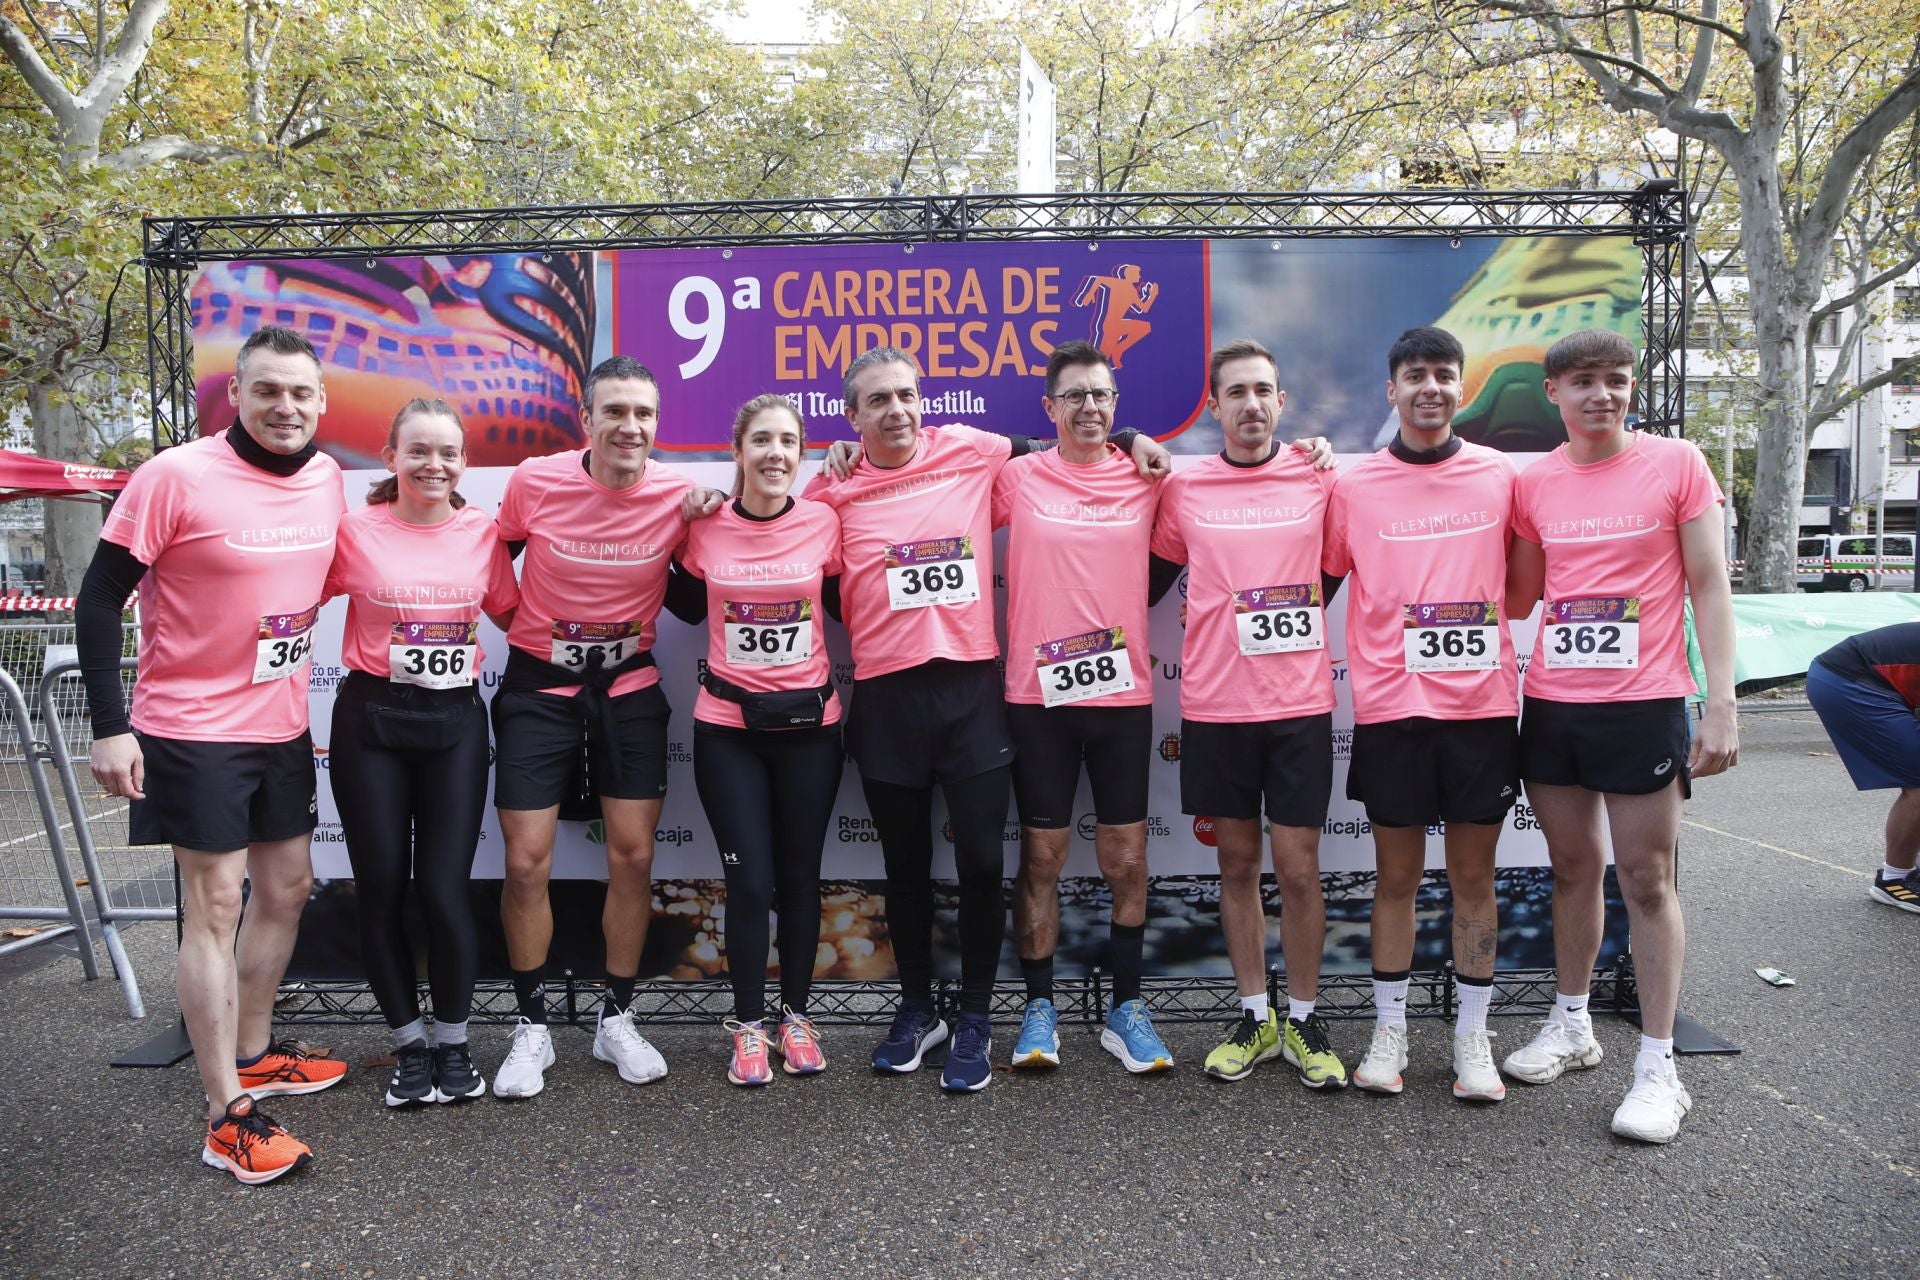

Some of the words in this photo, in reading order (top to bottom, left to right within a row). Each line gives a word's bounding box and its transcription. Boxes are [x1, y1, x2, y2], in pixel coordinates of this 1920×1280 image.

[773, 267, 988, 318] CARRERA
[1002, 267, 1061, 314] DE
[775, 319, 1062, 380] EMPRESAS
[914, 546, 948, 556] EMPRESAS
[900, 563, 964, 595] 369
[1265, 593, 1298, 602] EMPRESAS
[753, 610, 788, 618] EMPRESAS
[1435, 610, 1471, 619] EMPRESAS
[1570, 606, 1606, 615] EMPRESAS
[423, 630, 457, 638] EMPRESAS
[1250, 610, 1312, 641] 363
[268, 629, 312, 668] 364
[738, 625, 800, 654] 367
[1063, 640, 1097, 653] EMPRESAS
[1418, 629, 1486, 658] 365
[1554, 625, 1621, 654] 362
[404, 648, 466, 676] 366
[327, 667, 340, 676] DE
[1052, 655, 1117, 691] 368
[669, 742, 684, 752] DE
[838, 815, 876, 829] Ren
[1147, 816, 1162, 826] DE
[654, 825, 694, 847] caja
